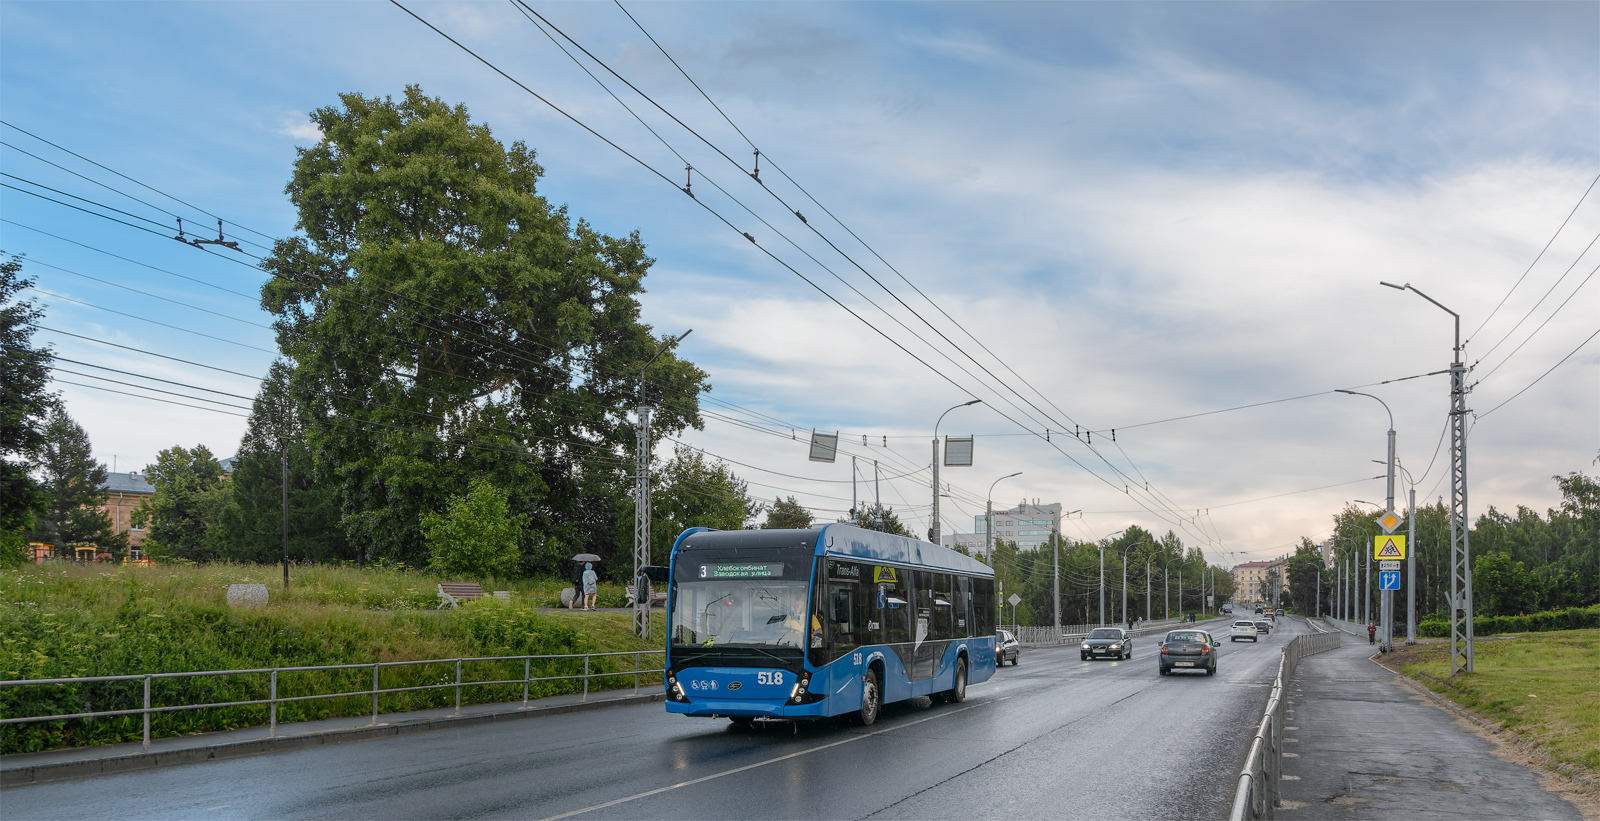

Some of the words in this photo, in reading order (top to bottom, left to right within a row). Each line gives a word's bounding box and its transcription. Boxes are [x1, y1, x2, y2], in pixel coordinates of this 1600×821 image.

[700, 565, 707, 578] 3
[836, 564, 859, 577] Trans-Alfa
[853, 652, 862, 666] 518
[757, 671, 784, 685] 518
